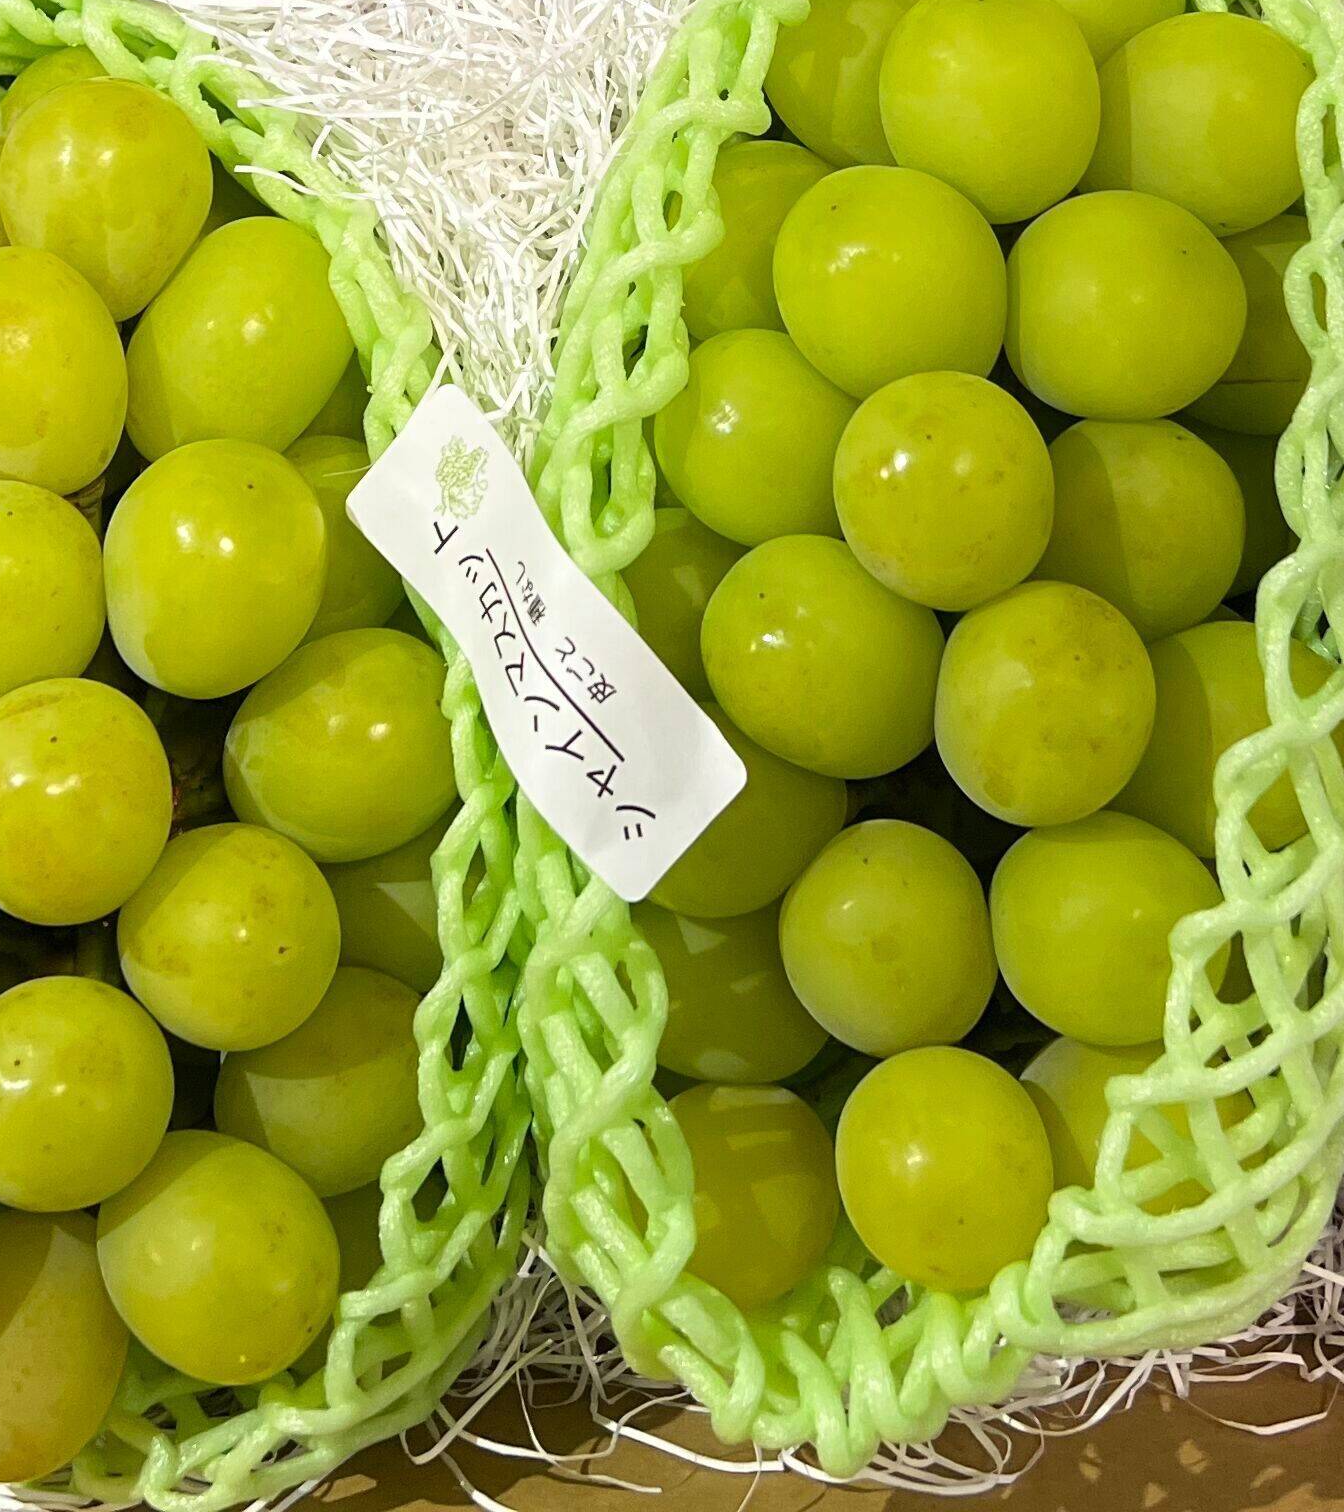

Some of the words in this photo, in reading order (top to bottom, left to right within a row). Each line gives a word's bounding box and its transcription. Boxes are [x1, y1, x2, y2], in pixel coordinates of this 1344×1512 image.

[434, 521, 656, 840] シャインマスカット
[555, 636, 618, 705] 皮ごと
